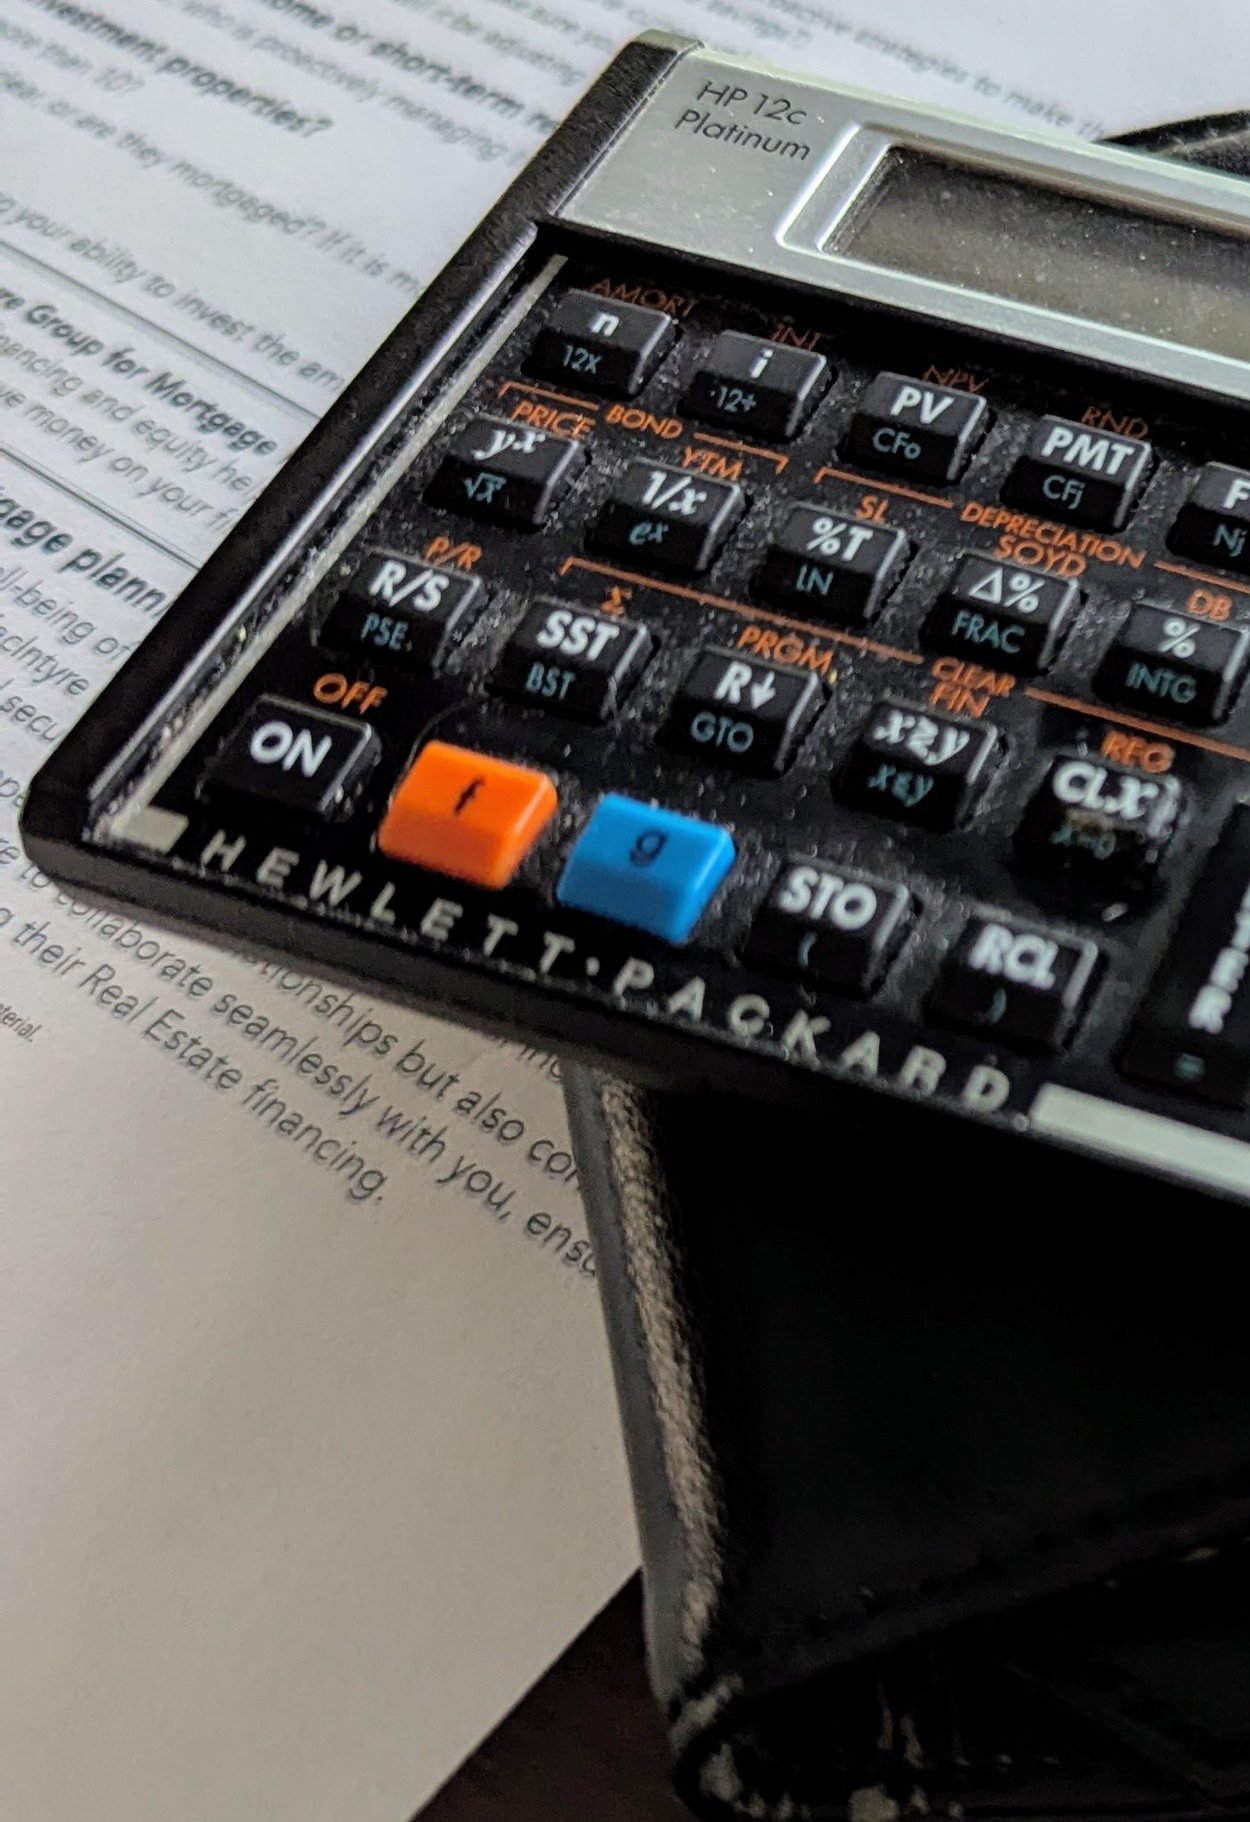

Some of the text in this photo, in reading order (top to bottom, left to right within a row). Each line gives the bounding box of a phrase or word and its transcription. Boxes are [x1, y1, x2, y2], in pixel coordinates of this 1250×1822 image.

[155, 56, 334, 138] properties?
[371, 41, 525, 119] short-term
[695, 79, 809, 127] HP 12c
[673, 107, 813, 164] Platinum
[115, 131, 172, 170] they
[168, 160, 328, 237] mortgaged?
[2, 205, 75, 242] your
[68, 236, 149, 286] ability
[144, 272, 177, 301] to
[173, 284, 257, 341] invest
[252, 329, 302, 368] the
[22, 302, 280, 458] Group for Mortgage
[889, 385, 956, 425] PV
[80, 386, 138, 424] and
[130, 415, 219, 475] equity
[505, 399, 599, 440] PRICE
[604, 403, 685, 441] BOND
[1079, 404, 1150, 440] RND
[22, 401, 119, 465] money
[108, 453, 151, 484] on
[136, 474, 215, 518] your
[680, 445, 744, 483] YTM
[1040, 425, 1136, 476] PMT
[641, 469, 709, 516] 1/x
[423, 535, 485, 571] P/R
[804, 515, 875, 563] %T
[959, 500, 1148, 571] DEPRECIATION
[994, 533, 1089, 579] SOYD
[0, 565, 98, 645] ll-being
[368, 558, 451, 613] R/S
[360, 610, 410, 651] PSE
[535, 608, 622, 663] SST
[736, 624, 835, 677] PRGM
[950, 608, 1027, 655] FRAC
[1159, 615, 1201, 660] %
[312, 671, 389, 716] OFF
[523, 660, 578, 701] BST
[1124, 661, 1199, 705] INTG
[249, 719, 333, 779] ON
[689, 709, 755, 753] GTO
[628, 827, 671, 870] g
[778, 865, 879, 931] STO
[967, 922, 1059, 992] RCL
[12, 920, 86, 976] their
[79, 961, 160, 1024] Real
[144, 1007, 244, 1091] Estate
[241, 1076, 388, 1208] financing.
[212, 992, 382, 1121] seamlessly
[373, 1103, 449, 1165] with
[433, 1153, 518, 1222] you,
[396, 1039, 462, 1100] but
[455, 1090, 526, 1144] also
